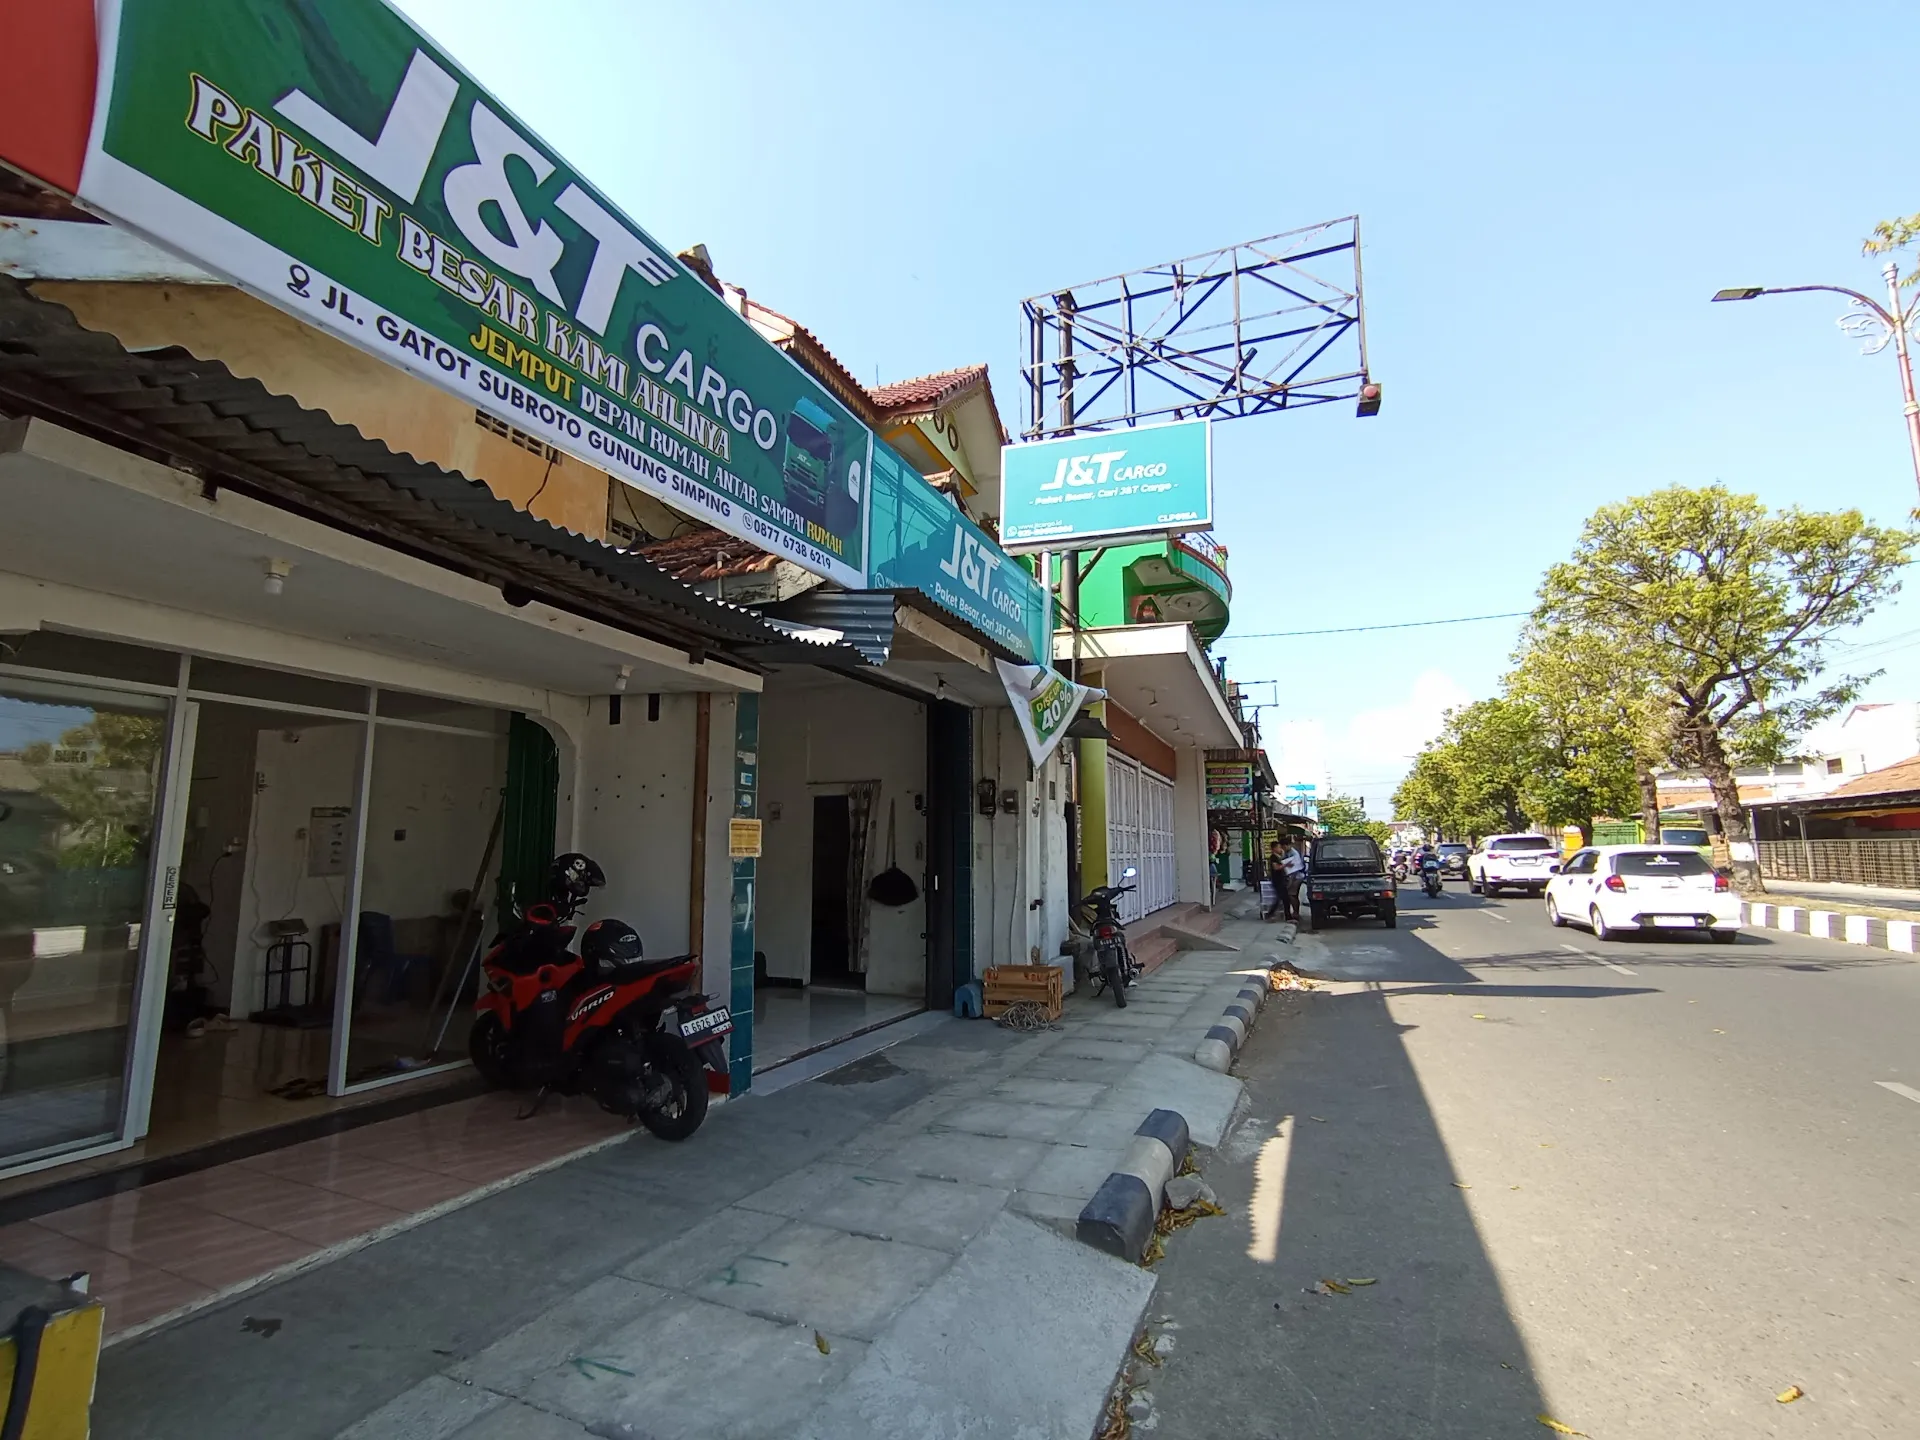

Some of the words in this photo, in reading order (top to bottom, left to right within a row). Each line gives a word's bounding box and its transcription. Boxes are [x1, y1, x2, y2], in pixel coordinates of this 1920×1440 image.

[185, 72, 392, 246] PAKET
[396, 213, 540, 344] BESAR
[544, 311, 629, 400] KAMI
[630, 373, 732, 463] AHLINYA
[272, 47, 679, 337] J&T
[636, 323, 777, 450] CARGO
[321, 285, 364, 326] JL.
[376, 315, 471, 380] GATOT
[478, 369, 582, 439] SUBROTO
[588, 430, 667, 484] GUNUNG
[671, 474, 731, 518] SIMPING
[754, 519, 780, 543] 0877
[783, 535, 807, 558] 6738
[809, 549, 831, 570] 6219
[470, 323, 575, 402] JEMPUT
[579, 385, 646, 444] DEPAN
[649, 427, 710, 482] RUMAH
[712, 466, 758, 509] ANTAR
[761, 494, 804, 534] SAMPAI
[806, 520, 843, 556] RUMAH
[1040, 450, 1128, 491] J&T
[1113, 462, 1167, 482] CARGO
[934, 582, 958, 608] Paket
[959, 597, 981, 625] Besar,
[981, 613, 995, 632] Cari
[939, 523, 1001, 602] J&T
[992, 588, 1021, 623] CARGO
[570, 991, 614, 1021] VARIO
